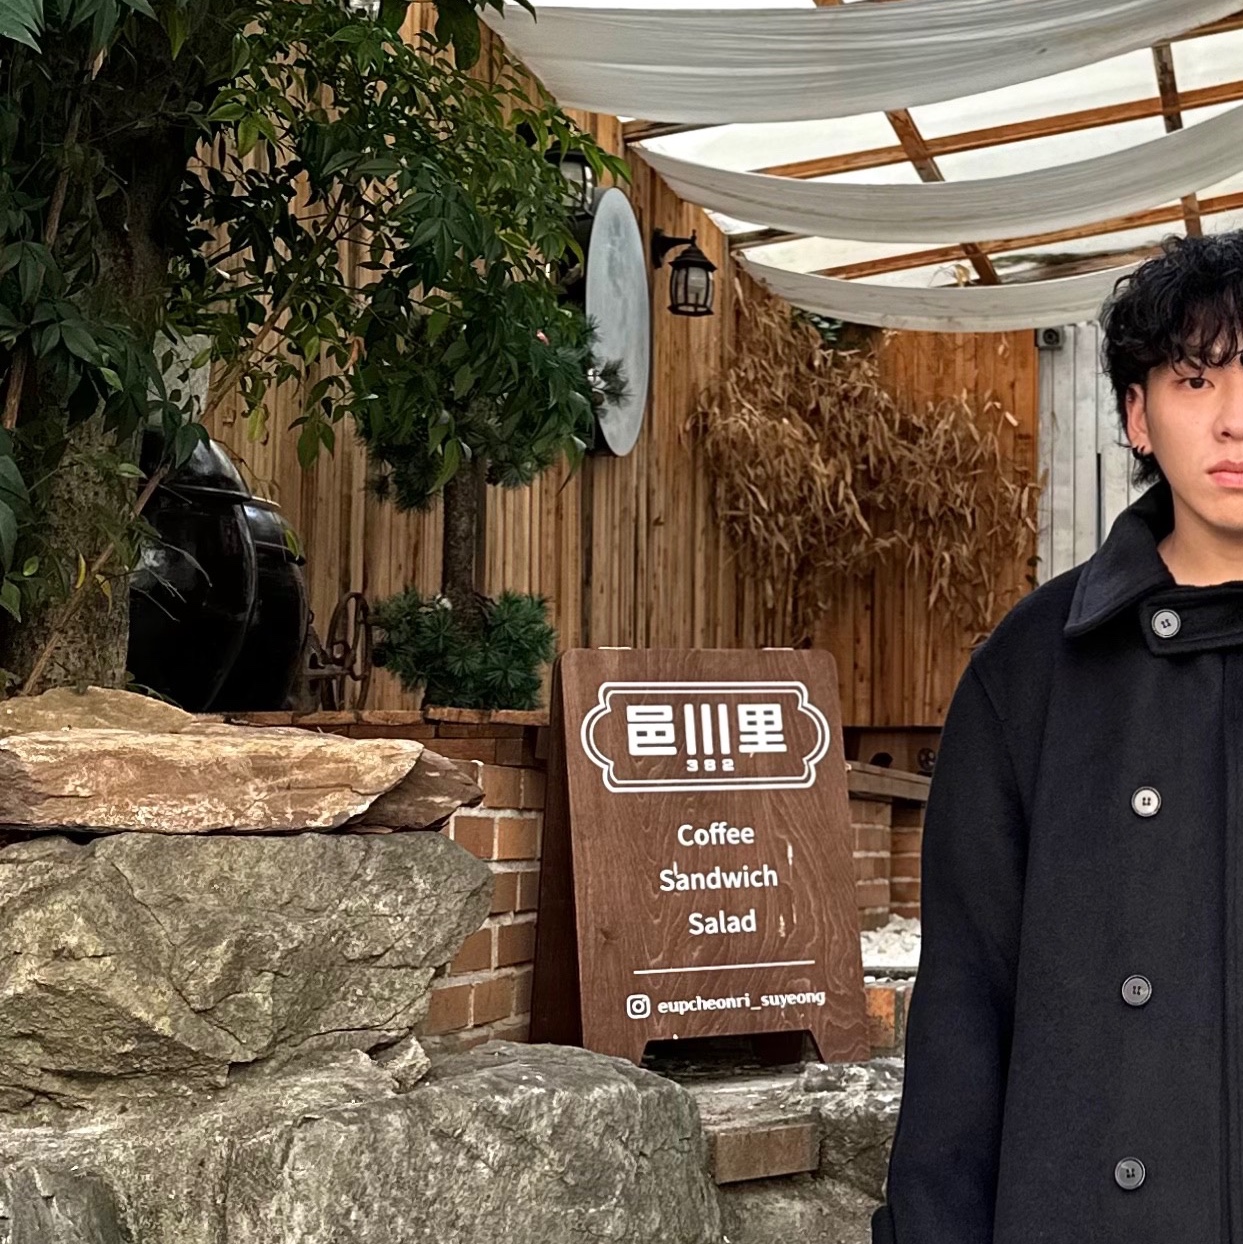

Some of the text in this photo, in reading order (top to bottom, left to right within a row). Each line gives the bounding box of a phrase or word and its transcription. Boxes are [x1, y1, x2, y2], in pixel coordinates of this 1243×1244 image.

[626, 703, 788, 756] 邑川里
[686, 758, 735, 772] 382
[677, 821, 755, 847] Coffee
[659, 863, 778, 892] Sandwich
[688, 908, 757, 935] Salad
[657, 991, 826, 1015] eupcheonri_suyeong
